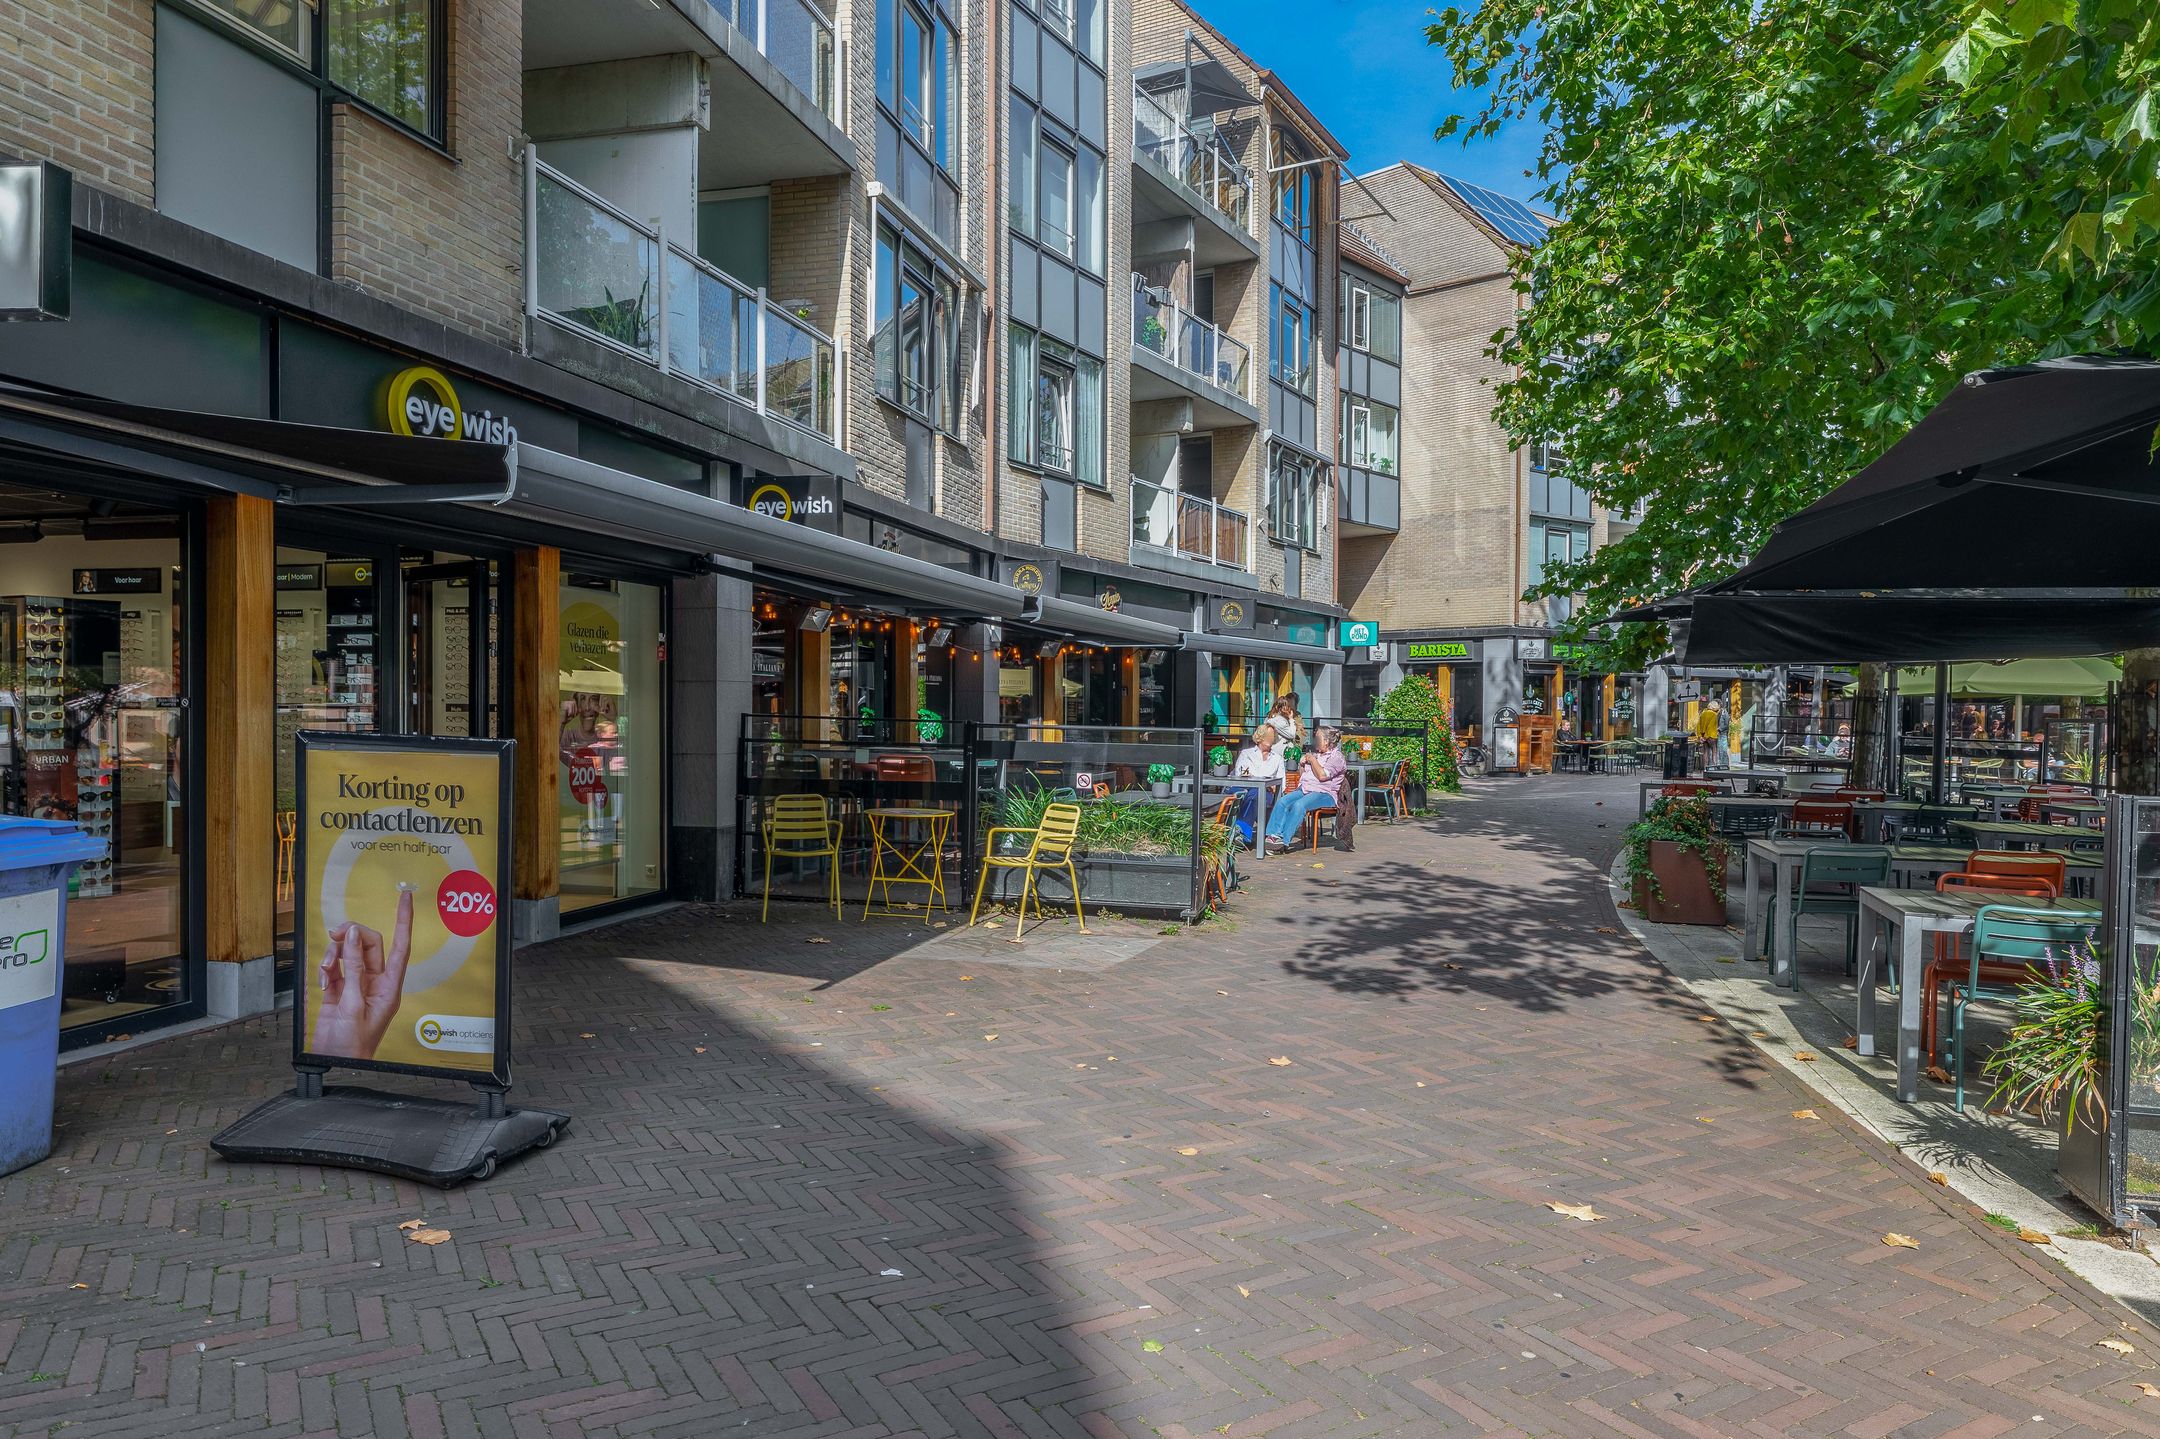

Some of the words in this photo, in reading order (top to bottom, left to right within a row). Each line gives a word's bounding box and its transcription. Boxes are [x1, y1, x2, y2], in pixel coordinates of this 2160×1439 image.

[406, 396, 456, 435] eye
[462, 410, 517, 445] wish
[755, 500, 787, 516] eye
[792, 496, 833, 514] wish
[567, 622, 595, 638] Glazen
[596, 626, 610, 640] die
[569, 640, 607, 655] verbazen
[1409, 643, 1467, 657] BARISTA
[35, 755, 69, 764] URBAN
[572, 766, 595, 785] 200
[338, 773, 431, 808] Korting
[434, 783, 465, 808] op
[320, 808, 486, 835] contactlenzen
[351, 841, 377, 851] voor
[379, 841, 401, 852] een
[404, 841, 426, 853] half
[426, 843, 453, 857] jaar
[440, 891, 494, 915] -20%
[423, 1028, 438, 1037] eye
[440, 1028, 458, 1037] wish
[459, 1030, 494, 1040] opticiens
